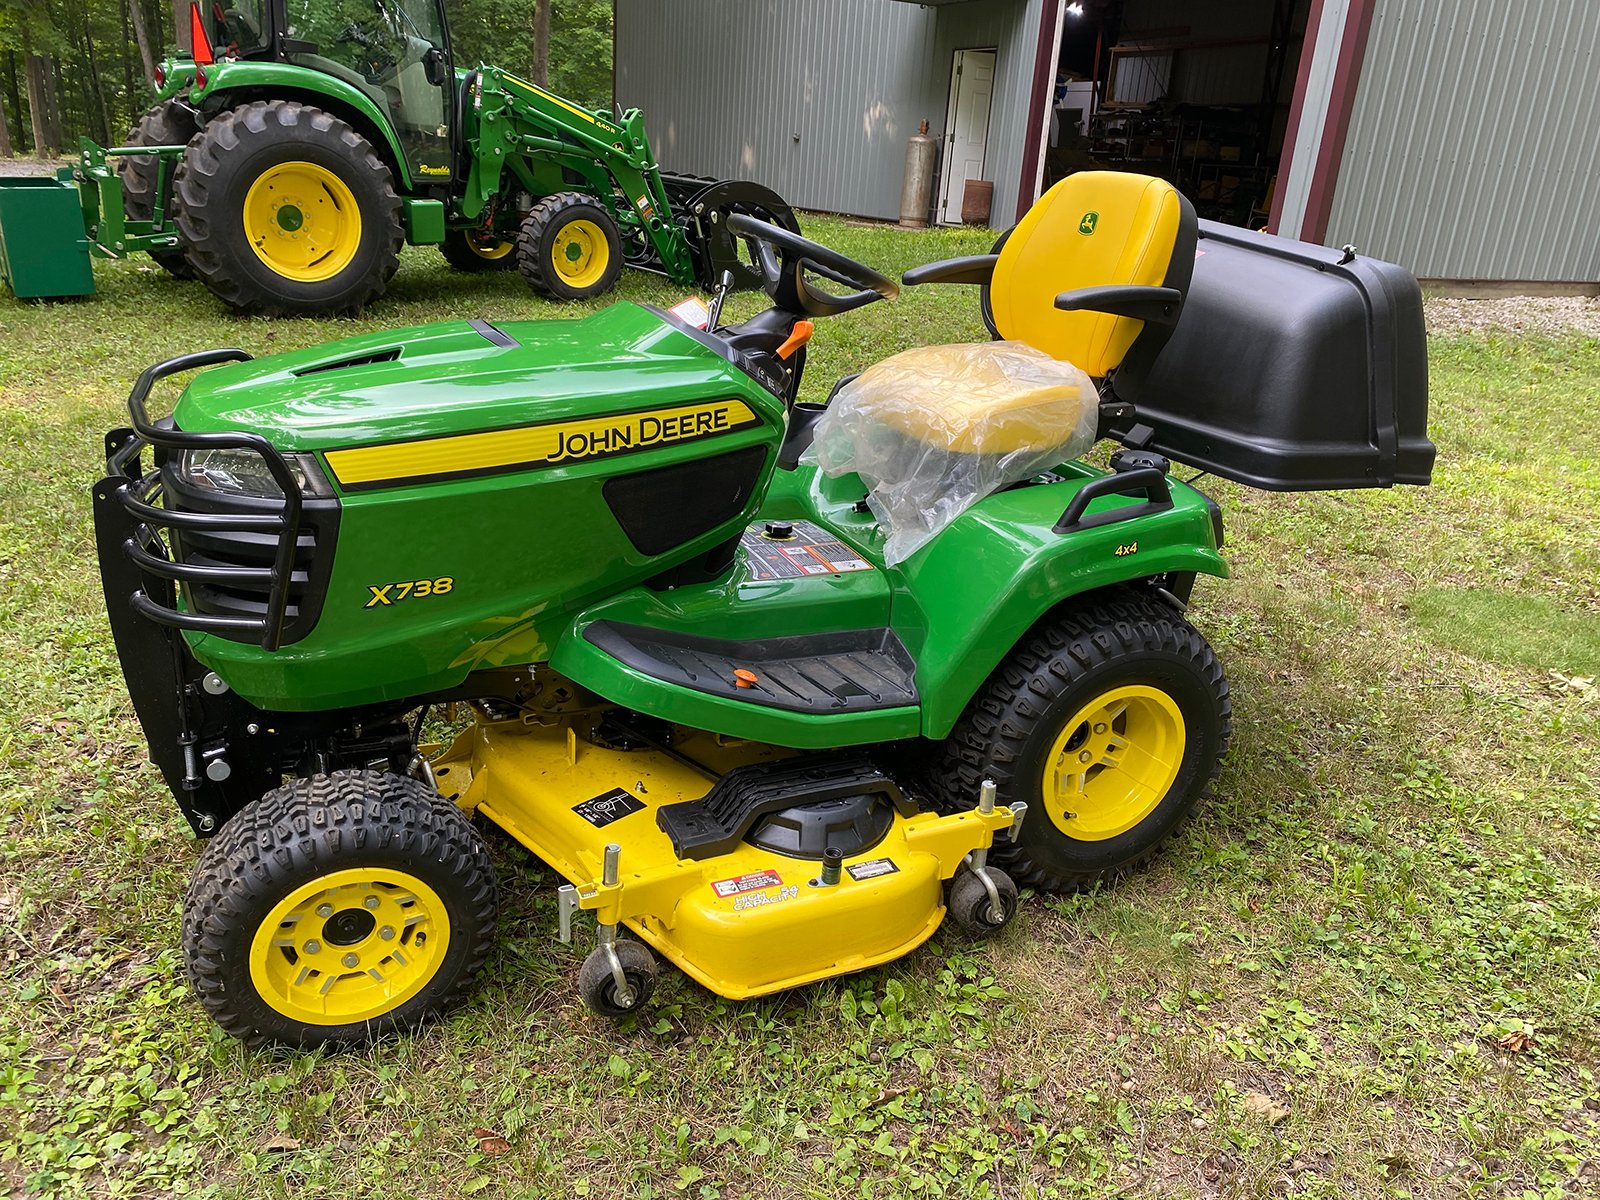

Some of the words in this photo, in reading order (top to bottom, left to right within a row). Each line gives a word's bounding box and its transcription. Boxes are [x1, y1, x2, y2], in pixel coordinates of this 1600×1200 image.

[596, 121, 611, 132] 440
[547, 425, 633, 461] JOHN
[639, 407, 730, 445] DEERE
[1114, 541, 1138, 556] 4x4
[363, 576, 454, 608] X738
[733, 889, 799, 911] CAPACITY
[735, 892, 766, 904] HIGH
[780, 885, 799, 896] 54
